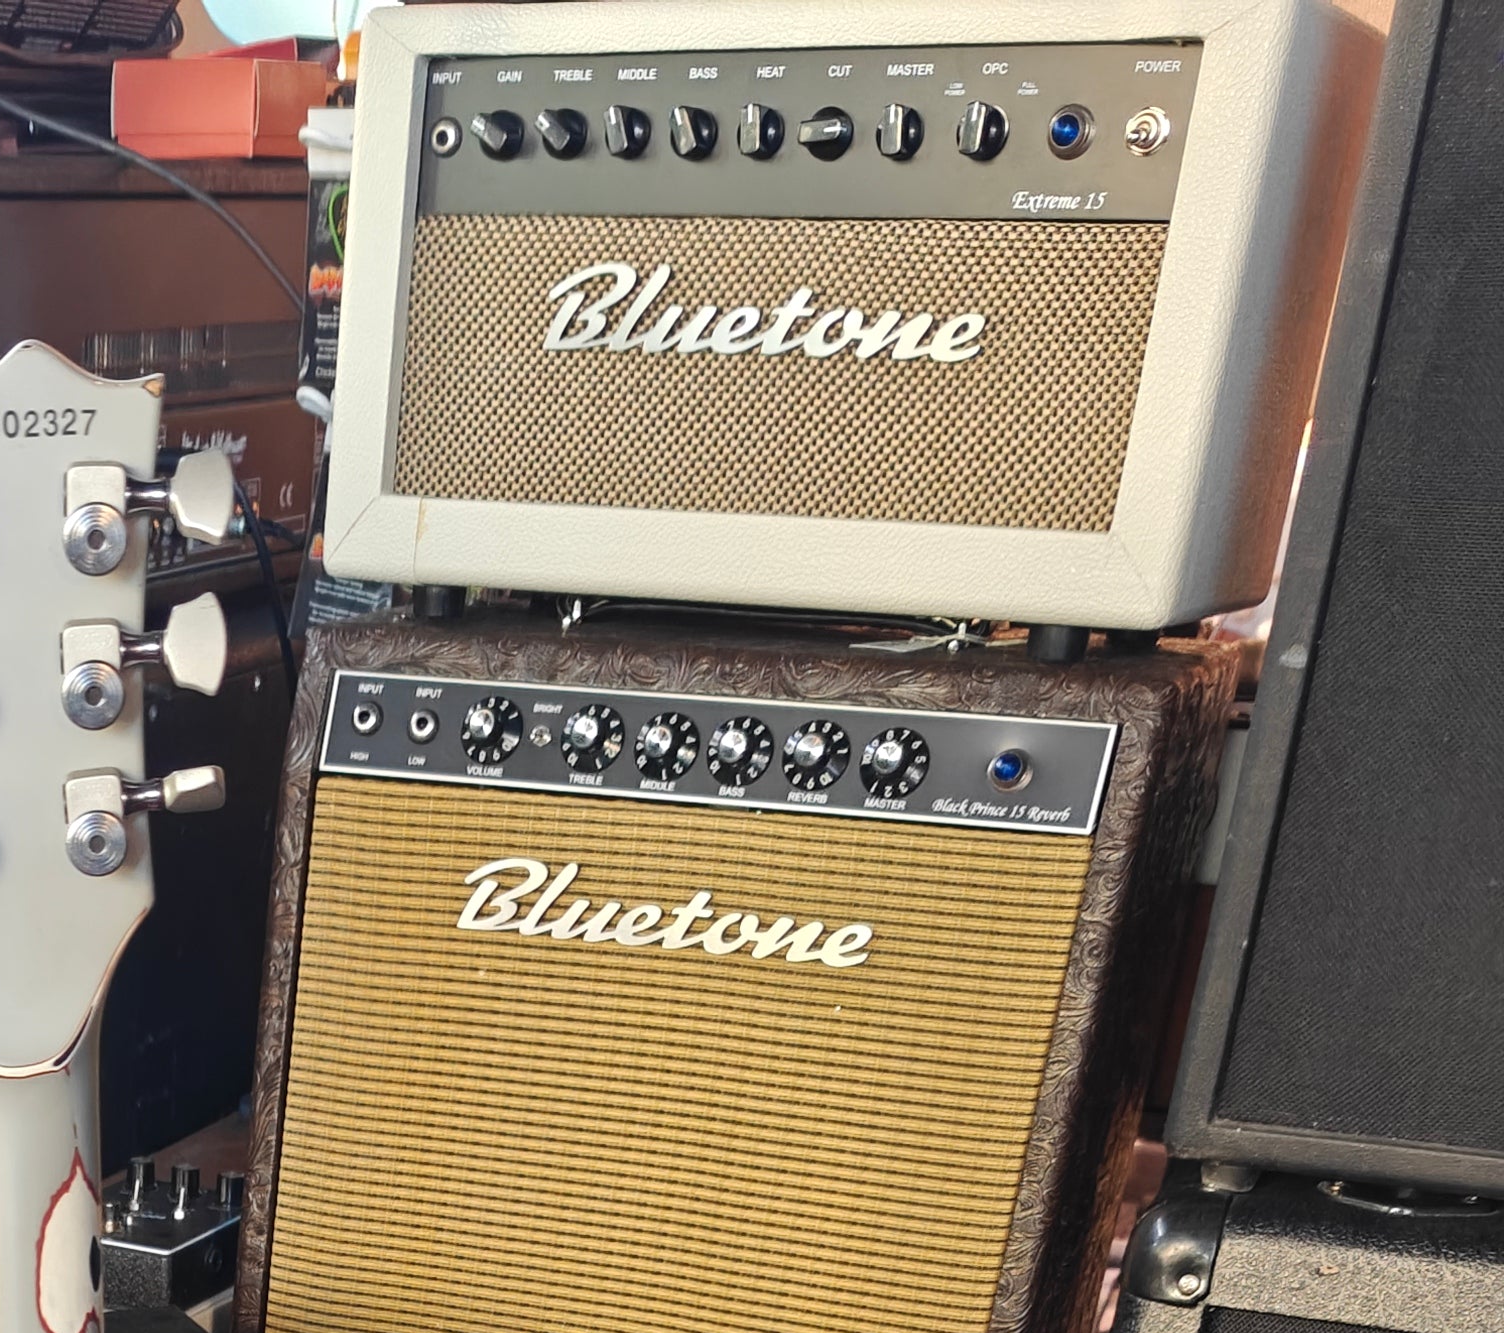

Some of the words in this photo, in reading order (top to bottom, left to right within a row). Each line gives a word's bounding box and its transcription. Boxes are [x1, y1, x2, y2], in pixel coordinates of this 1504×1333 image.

[757, 66, 785, 78] HEAT
[828, 65, 852, 78] CUT
[886, 63, 935, 76] MASTER
[982, 62, 1009, 75] OPC
[1135, 60, 1181, 73] POWER
[432, 72, 462, 84] INPUT
[497, 71, 523, 83] GAIN
[554, 69, 593, 82] TREBLE
[618, 68, 658, 81] MIDDLE
[689, 67, 718, 80] BASS
[1012, 190, 1080, 211] Extreme
[1085, 192, 1107, 210] 15
[543, 261, 985, 362] Bluetone
[358, 683, 384, 695] INPUT
[416, 688, 443, 700] INPUT
[533, 703, 563, 714] BRIGHT
[408, 756, 427, 766] LOW
[467, 766, 504, 778] VOLUME
[568, 774, 604, 786] TREBLE
[639, 780, 676, 792] MIDDLE
[718, 787, 746, 798] BASS
[787, 793, 828, 805] REVERB
[864, 798, 907, 811] MASTER
[932, 798, 968, 815] Black
[969, 803, 1007, 818] Prince
[1010, 805, 1025, 818] 15
[1027, 807, 1071, 822] Reverb
[457, 858, 873, 968] Bluetone
